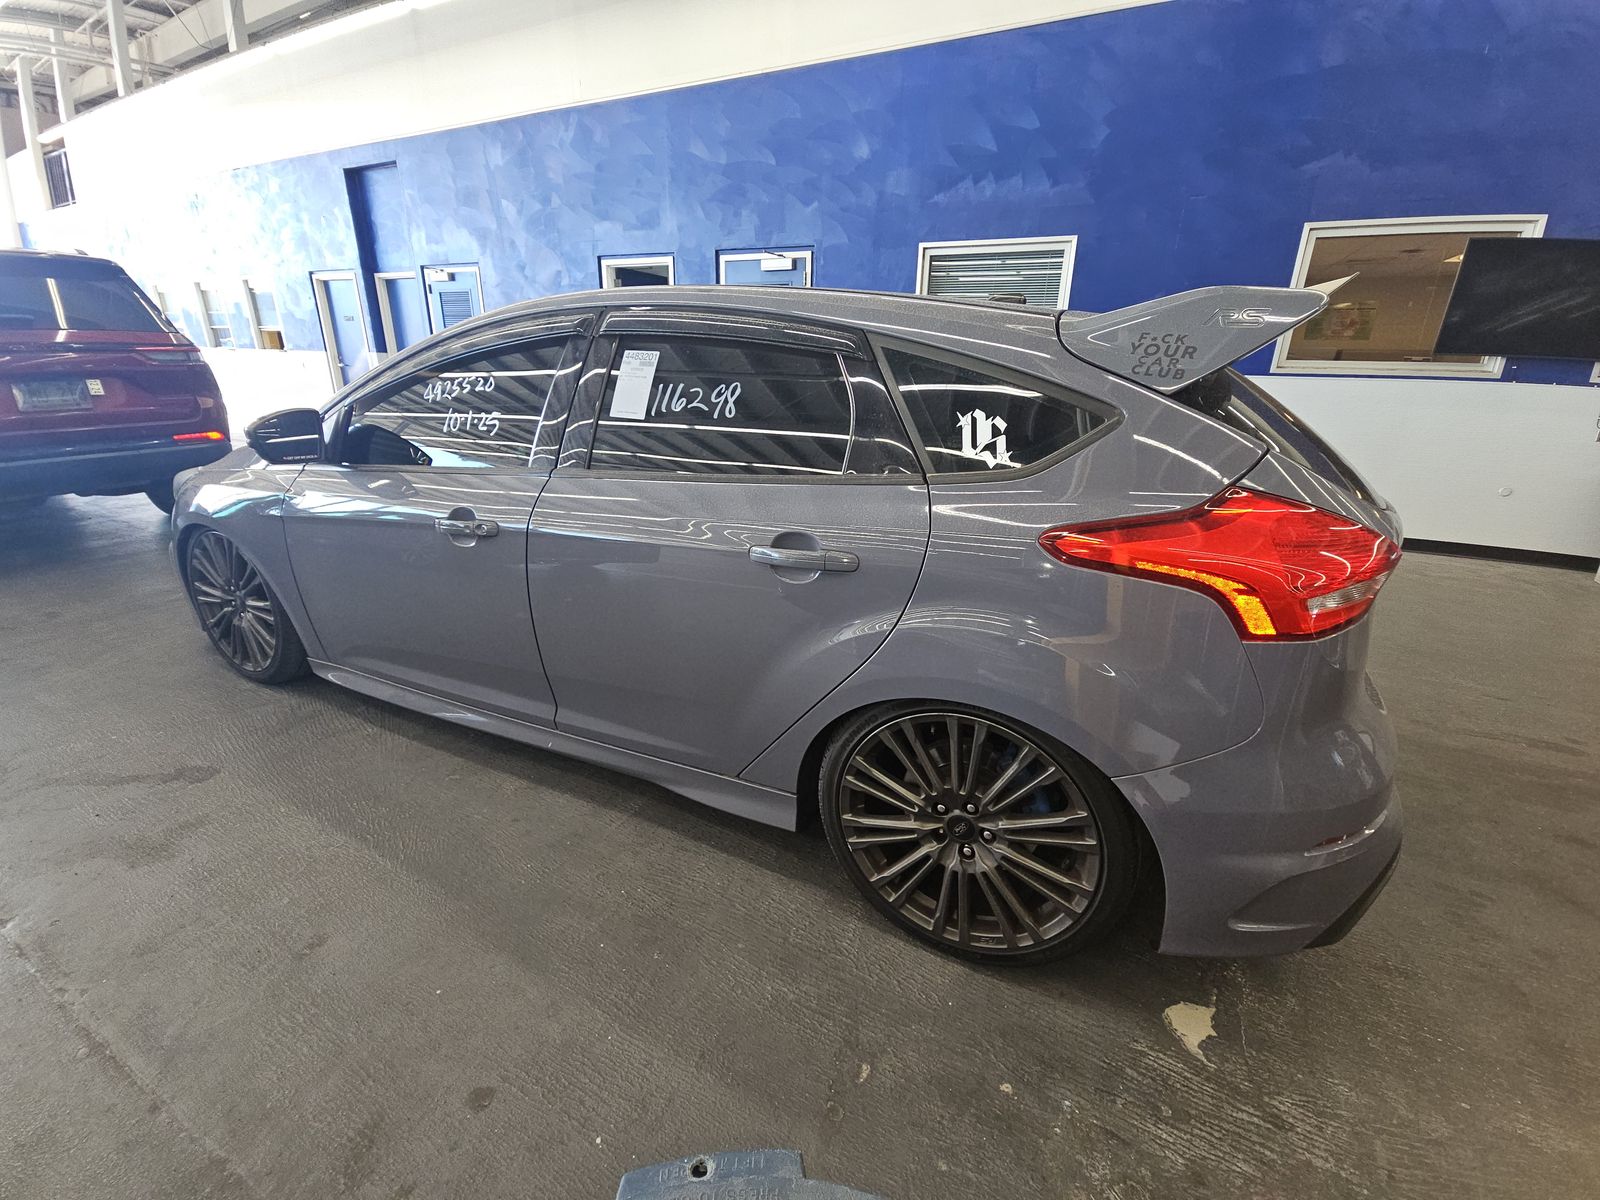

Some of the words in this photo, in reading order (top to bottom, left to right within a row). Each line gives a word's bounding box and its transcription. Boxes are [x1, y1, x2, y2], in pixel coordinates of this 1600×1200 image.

[624, 351, 658, 361] 4483201
[1130, 342, 1198, 359] YOUR
[1137, 355, 1180, 368] CAR
[1131, 364, 1186, 380] CLUB
[423, 376, 495, 403] 4925520
